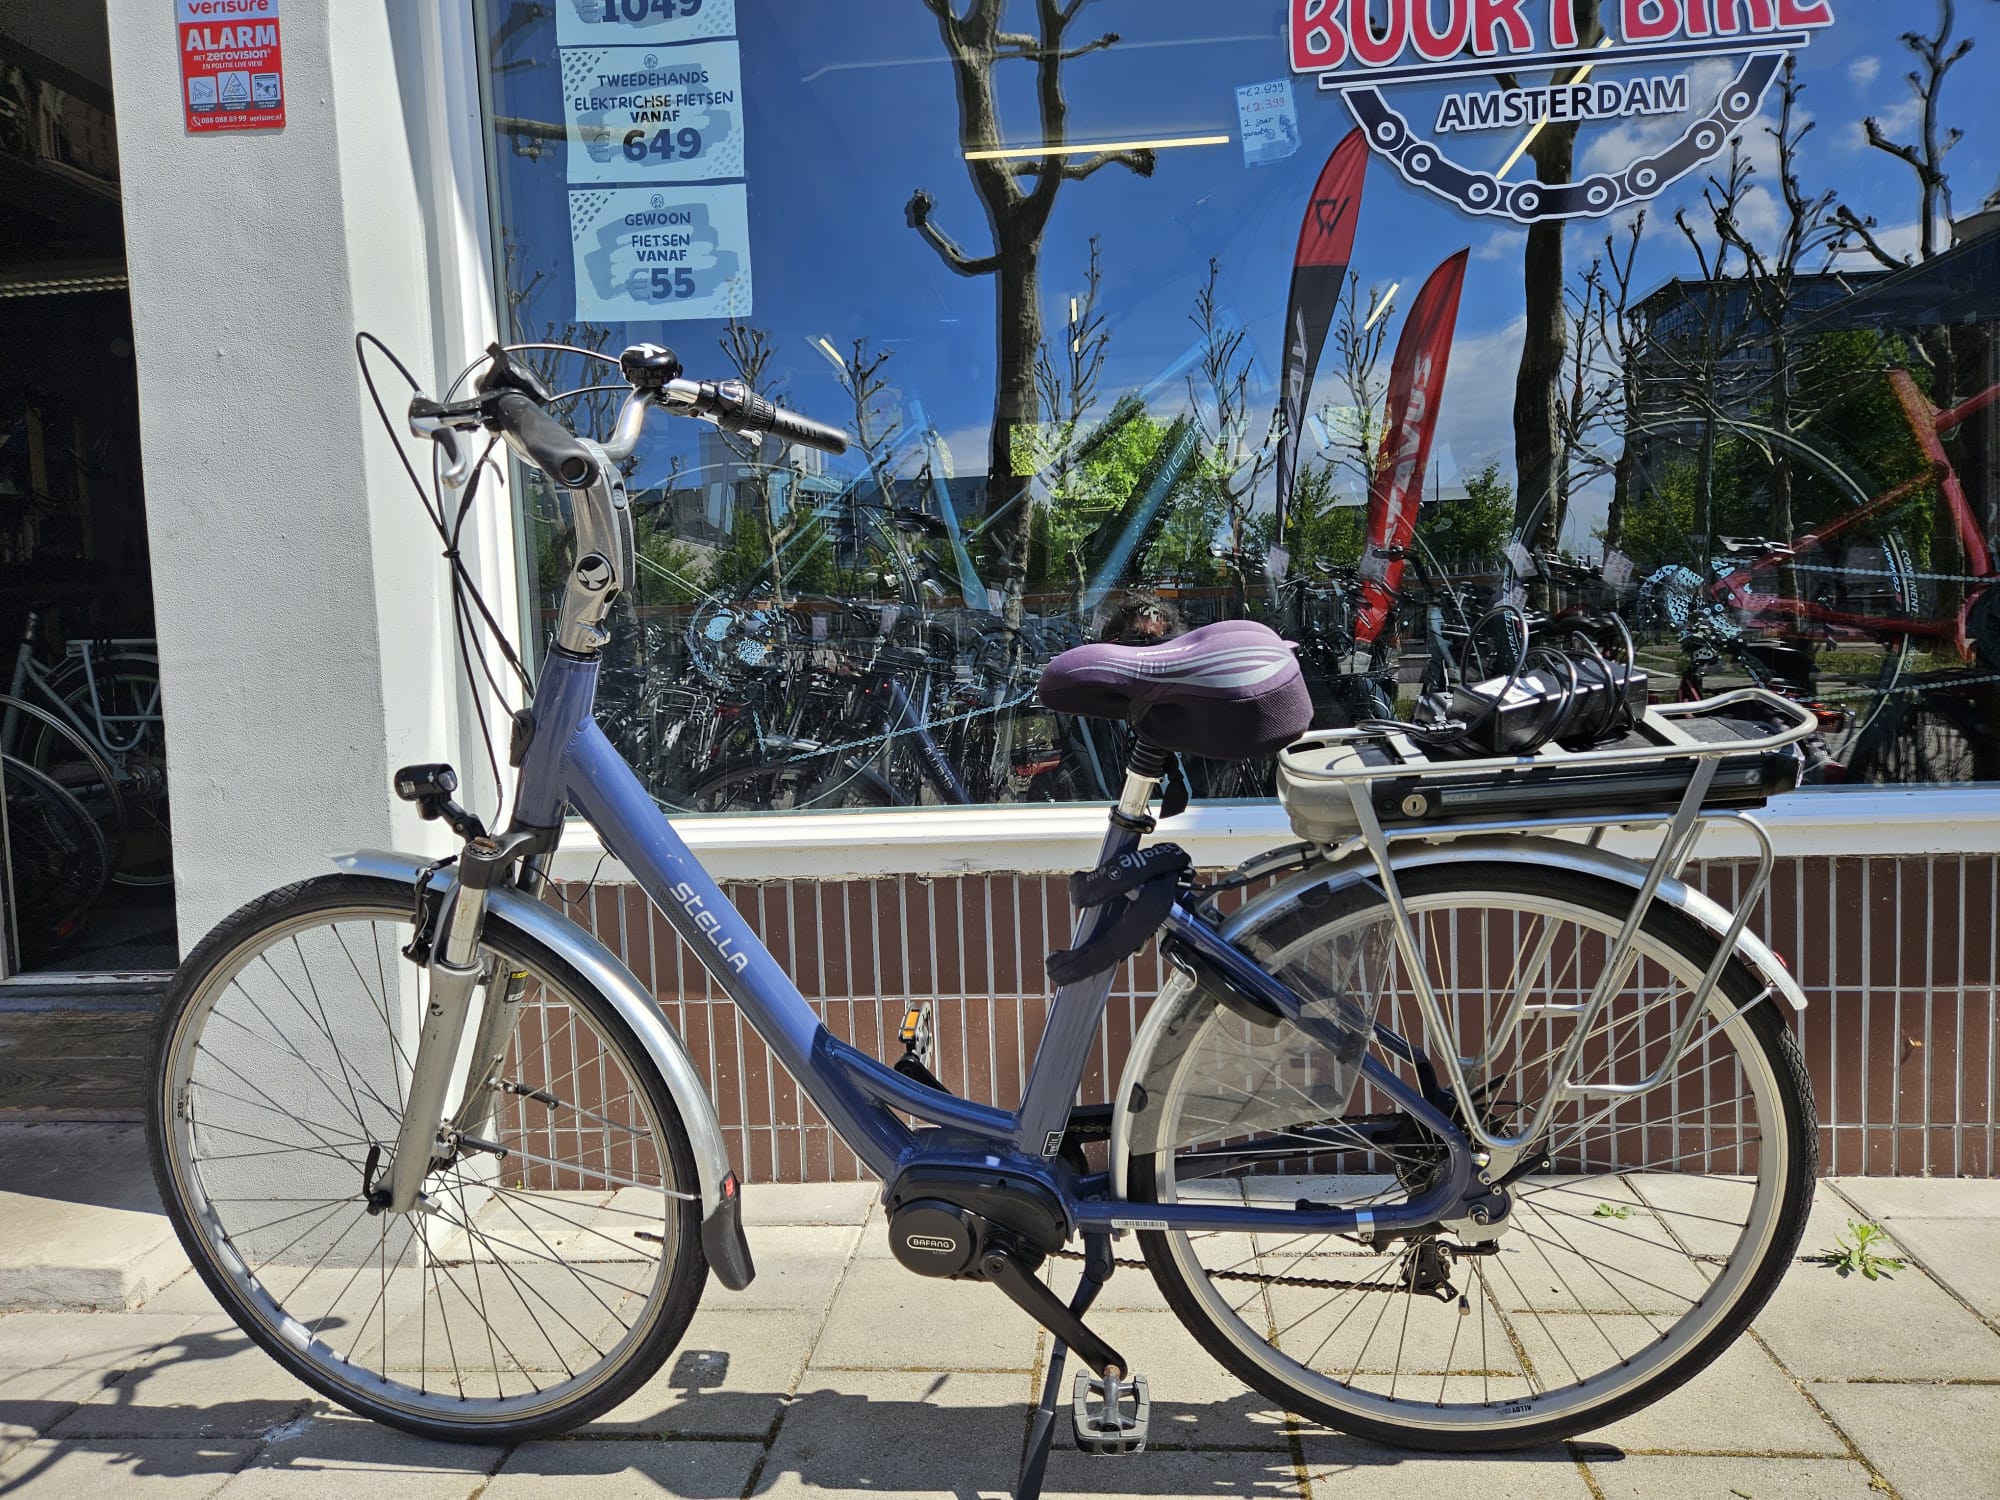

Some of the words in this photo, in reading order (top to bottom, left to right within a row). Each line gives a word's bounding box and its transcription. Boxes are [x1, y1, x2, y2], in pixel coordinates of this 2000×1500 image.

[186, 25, 277, 51] ALARM
[247, 60, 263, 68] VIEW
[597, 71, 709, 88] TWEEDEHANDS
[575, 94, 672, 111] ELEKTRICHSE
[676, 90, 734, 106] FIETSEN
[1437, 77, 1688, 130] AMSTERDAM
[249, 113, 283, 122] verisure.nl
[630, 110, 680, 123] VANAF
[624, 211, 691, 226] GEWOON
[631, 233, 690, 248] FIETSEN
[636, 250, 687, 262] VANAF
[1161, 403, 1214, 484] VICTORIA
[912, 1238, 950, 1249] BAFANG
